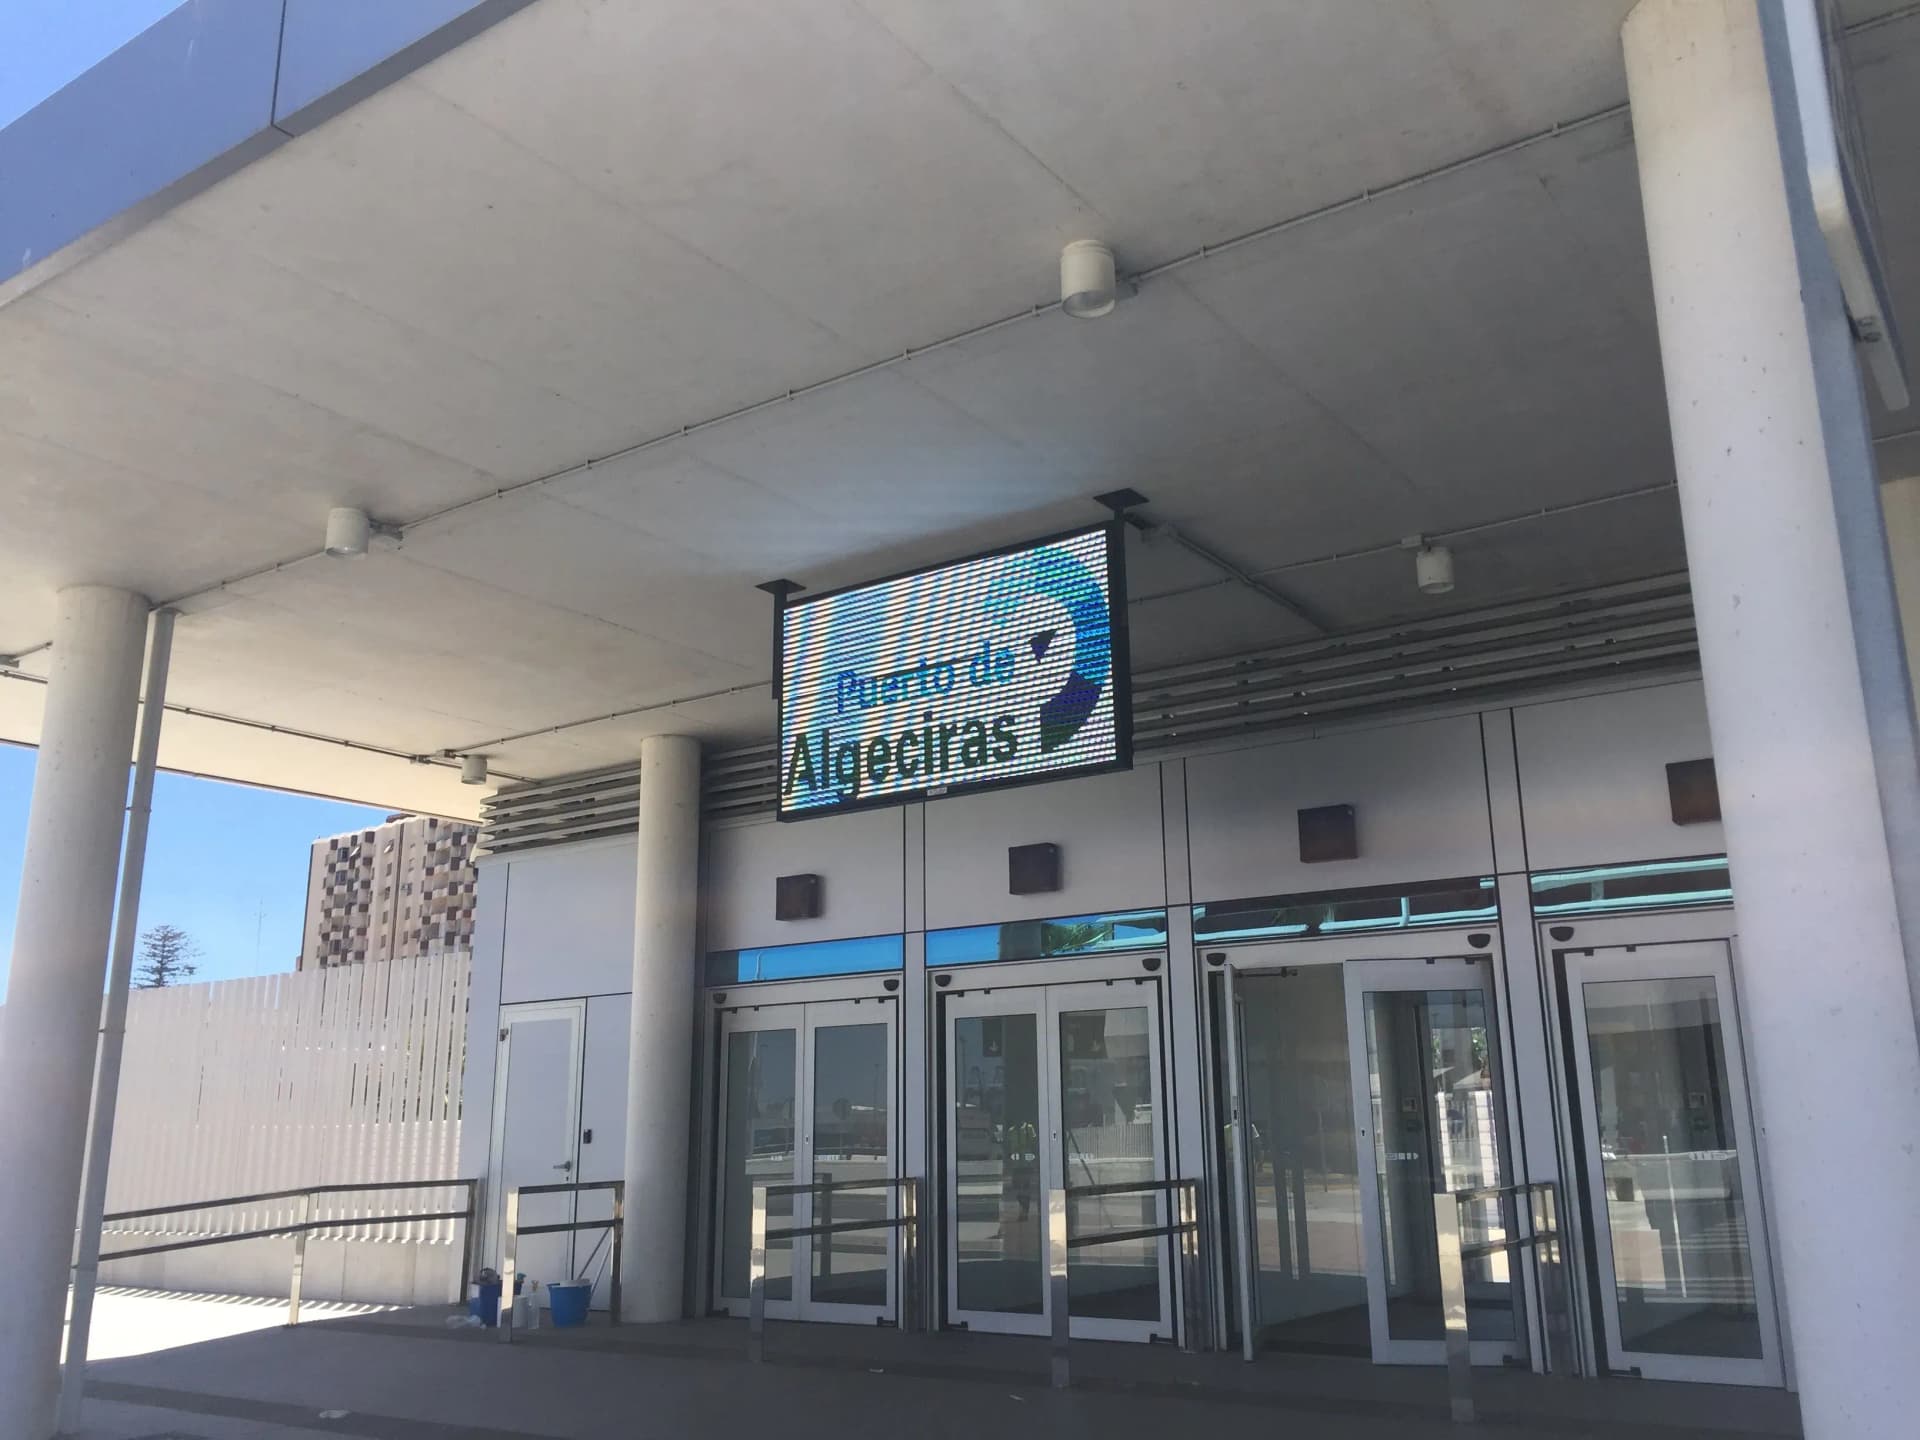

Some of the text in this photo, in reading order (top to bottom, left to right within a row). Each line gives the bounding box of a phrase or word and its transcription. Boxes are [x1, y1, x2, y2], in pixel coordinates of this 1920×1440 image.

[837, 640, 1016, 714] Puerto de
[782, 710, 1019, 800] Algeciras
